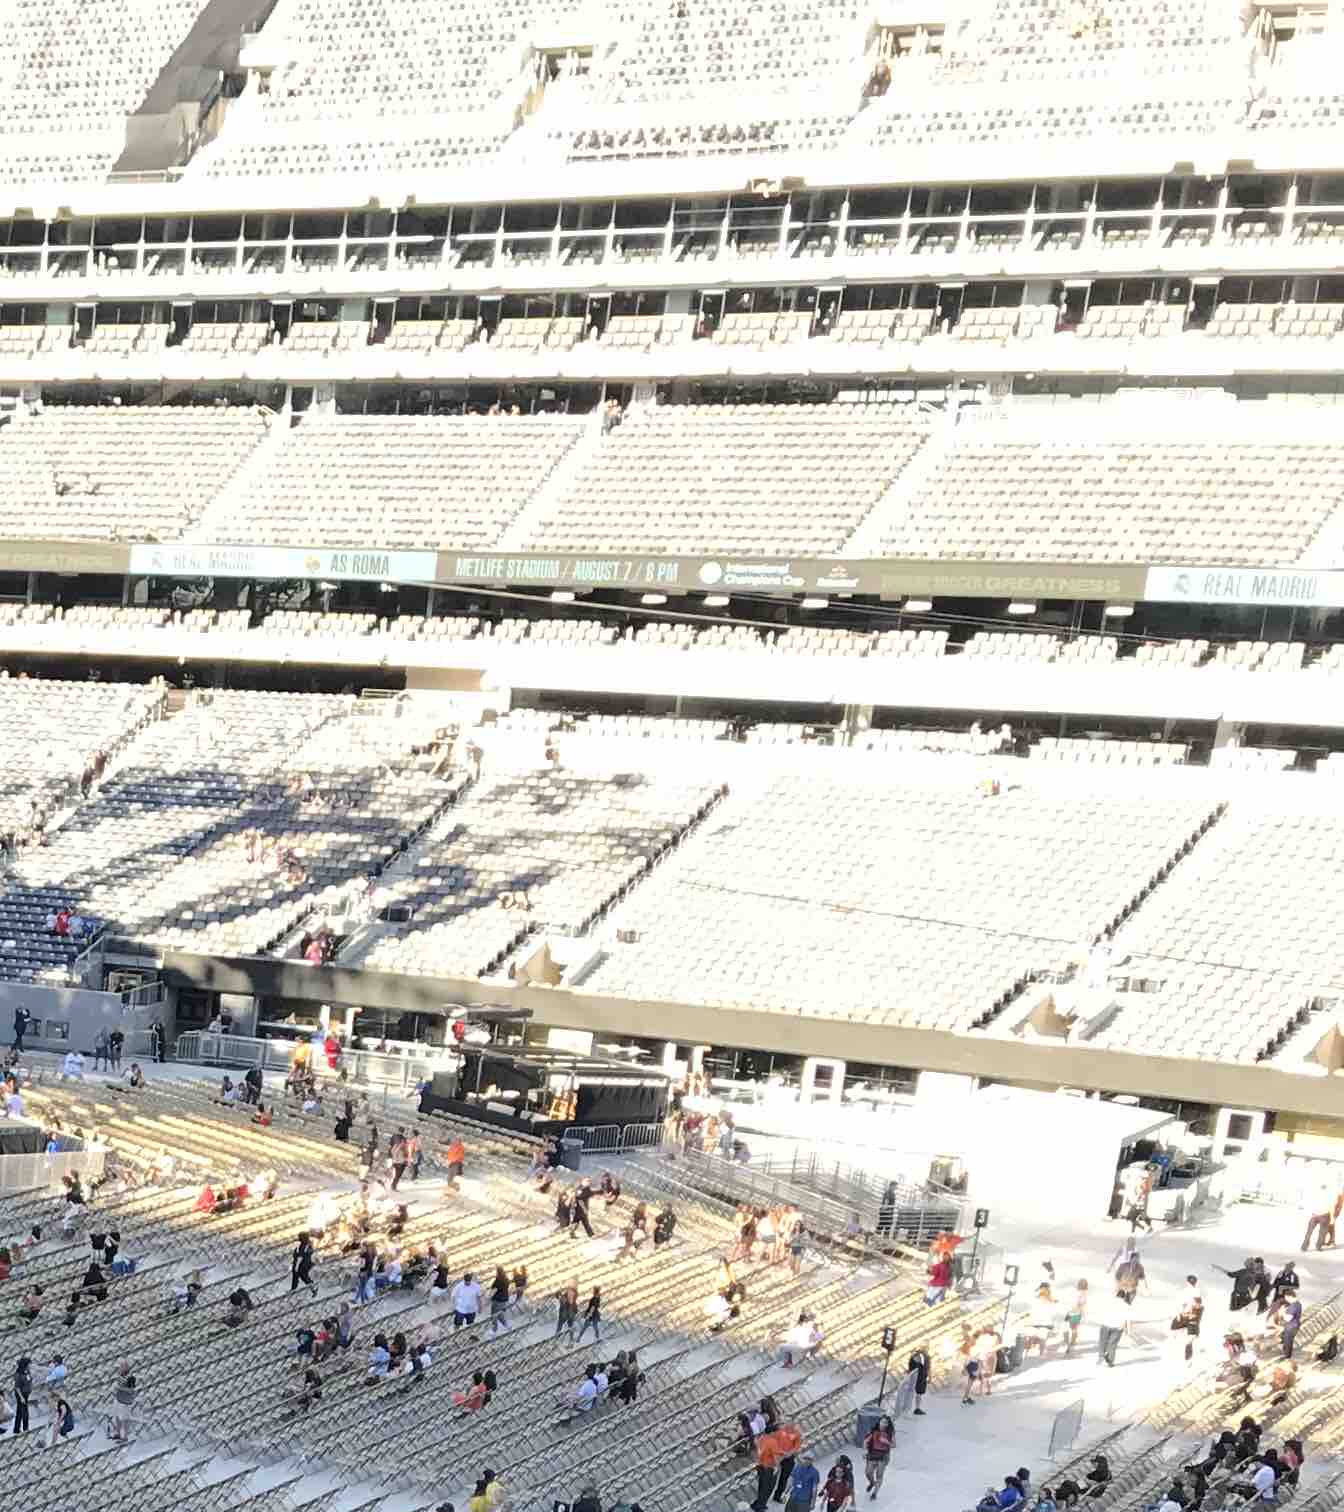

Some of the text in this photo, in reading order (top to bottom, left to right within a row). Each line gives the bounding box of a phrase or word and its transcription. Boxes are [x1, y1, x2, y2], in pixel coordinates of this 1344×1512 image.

[330, 554, 391, 576] AS ROMA
[455, 557, 505, 578] METLIFE
[572, 559, 620, 581] AUGUST
[656, 562, 680, 582] PM
[1202, 572, 1242, 597] REAL
